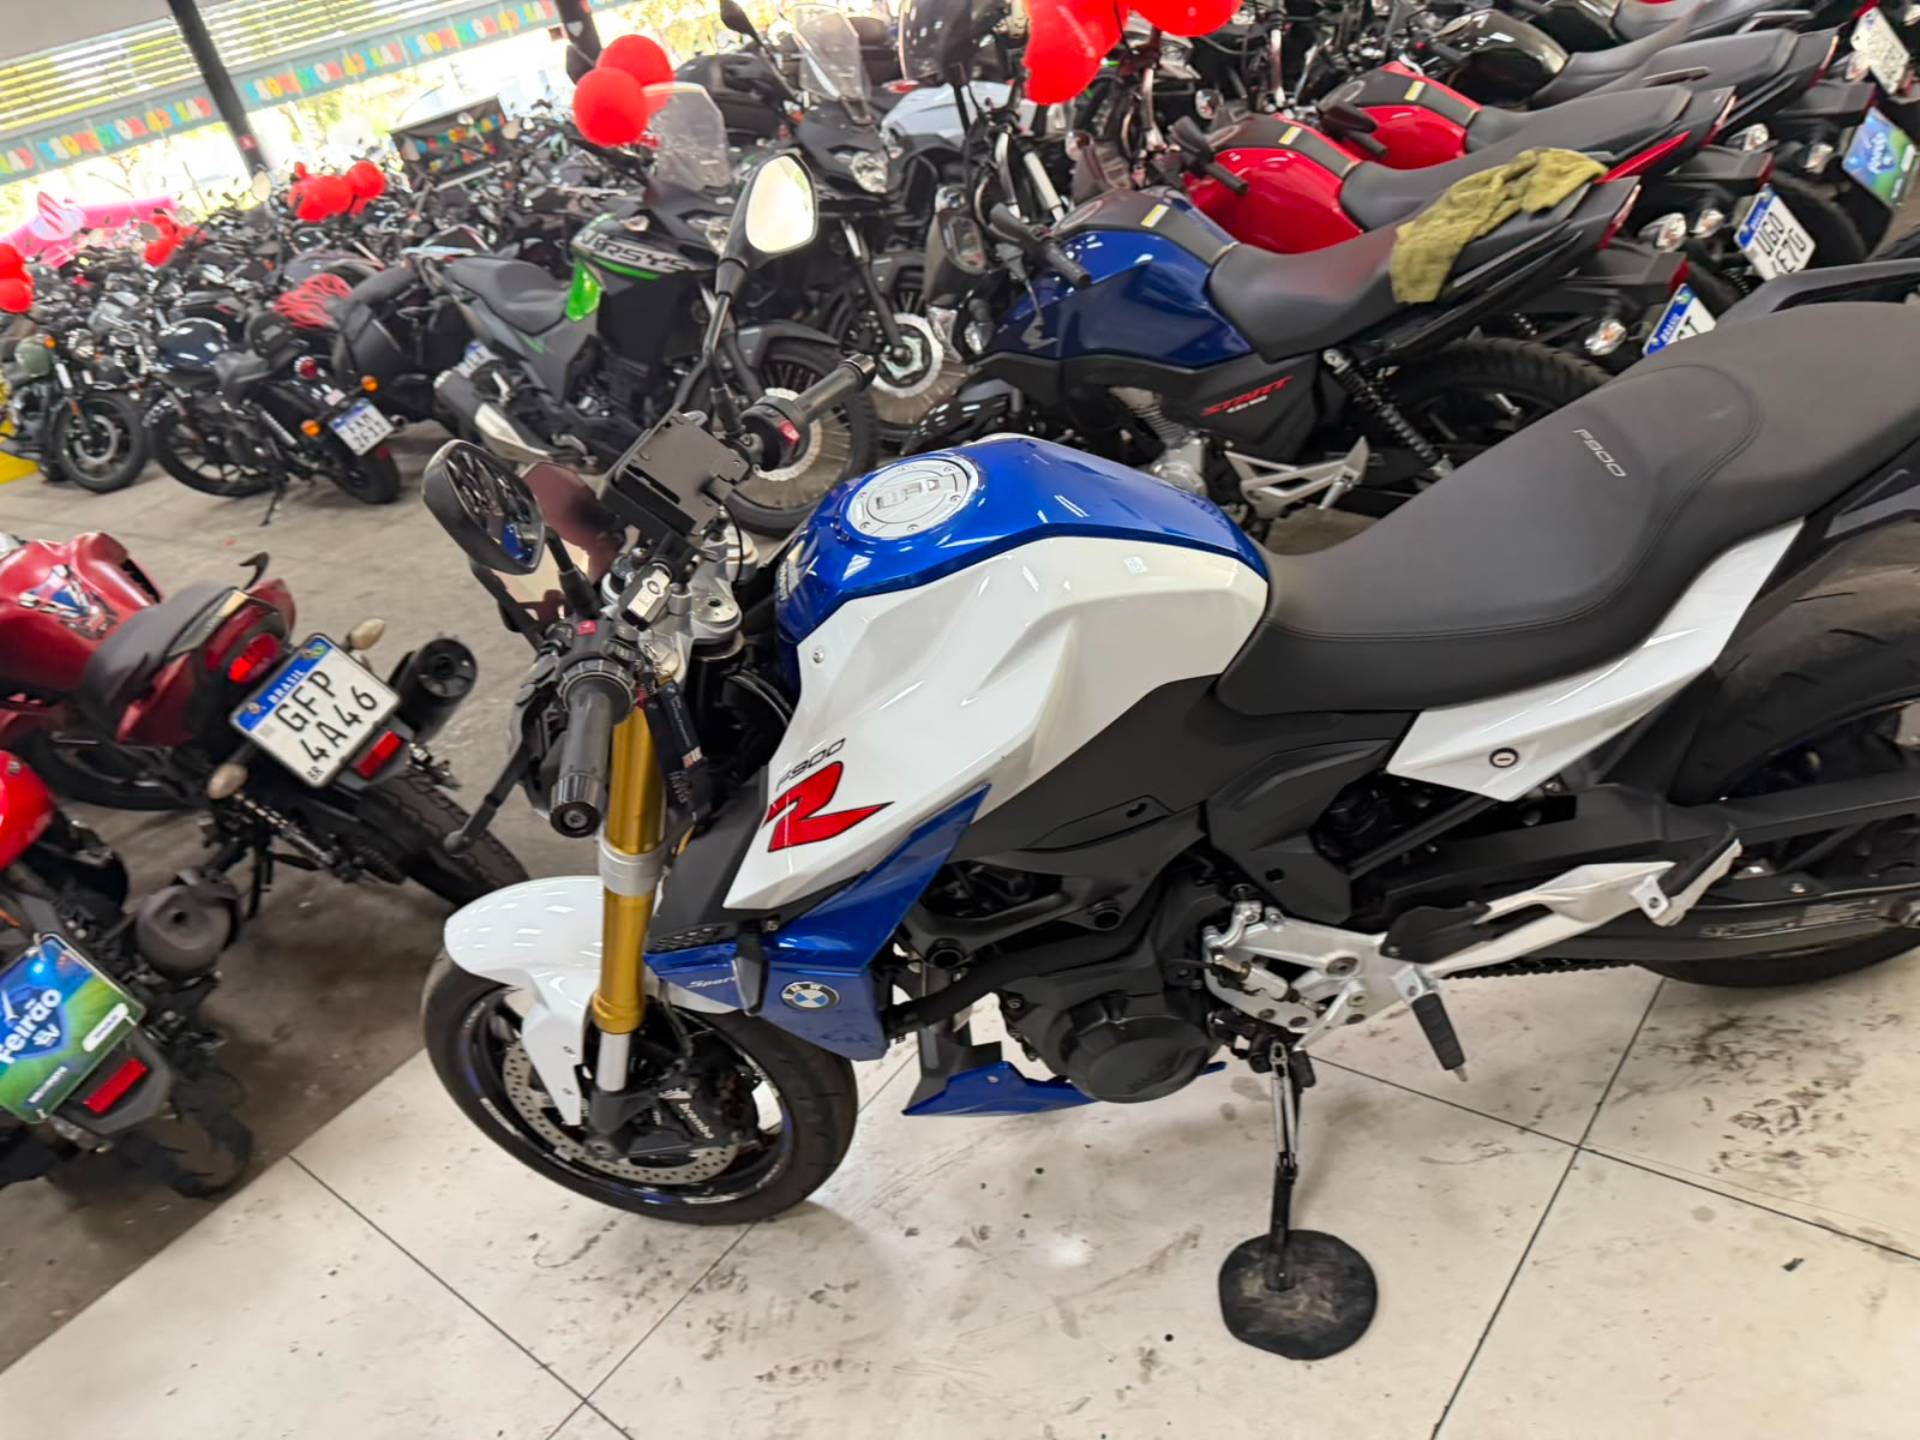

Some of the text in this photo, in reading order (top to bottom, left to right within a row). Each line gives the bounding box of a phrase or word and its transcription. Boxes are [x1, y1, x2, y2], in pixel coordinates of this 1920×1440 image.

[1573, 429, 1626, 477] F900
[266, 668, 307, 704] BRASIL
[274, 670, 337, 733] GFP
[300, 685, 378, 762] 4A46
[776, 738, 846, 792] F900
[761, 760, 895, 853] R
[0, 988, 62, 1064] Feirão
[678, 1102, 715, 1140] brembo
